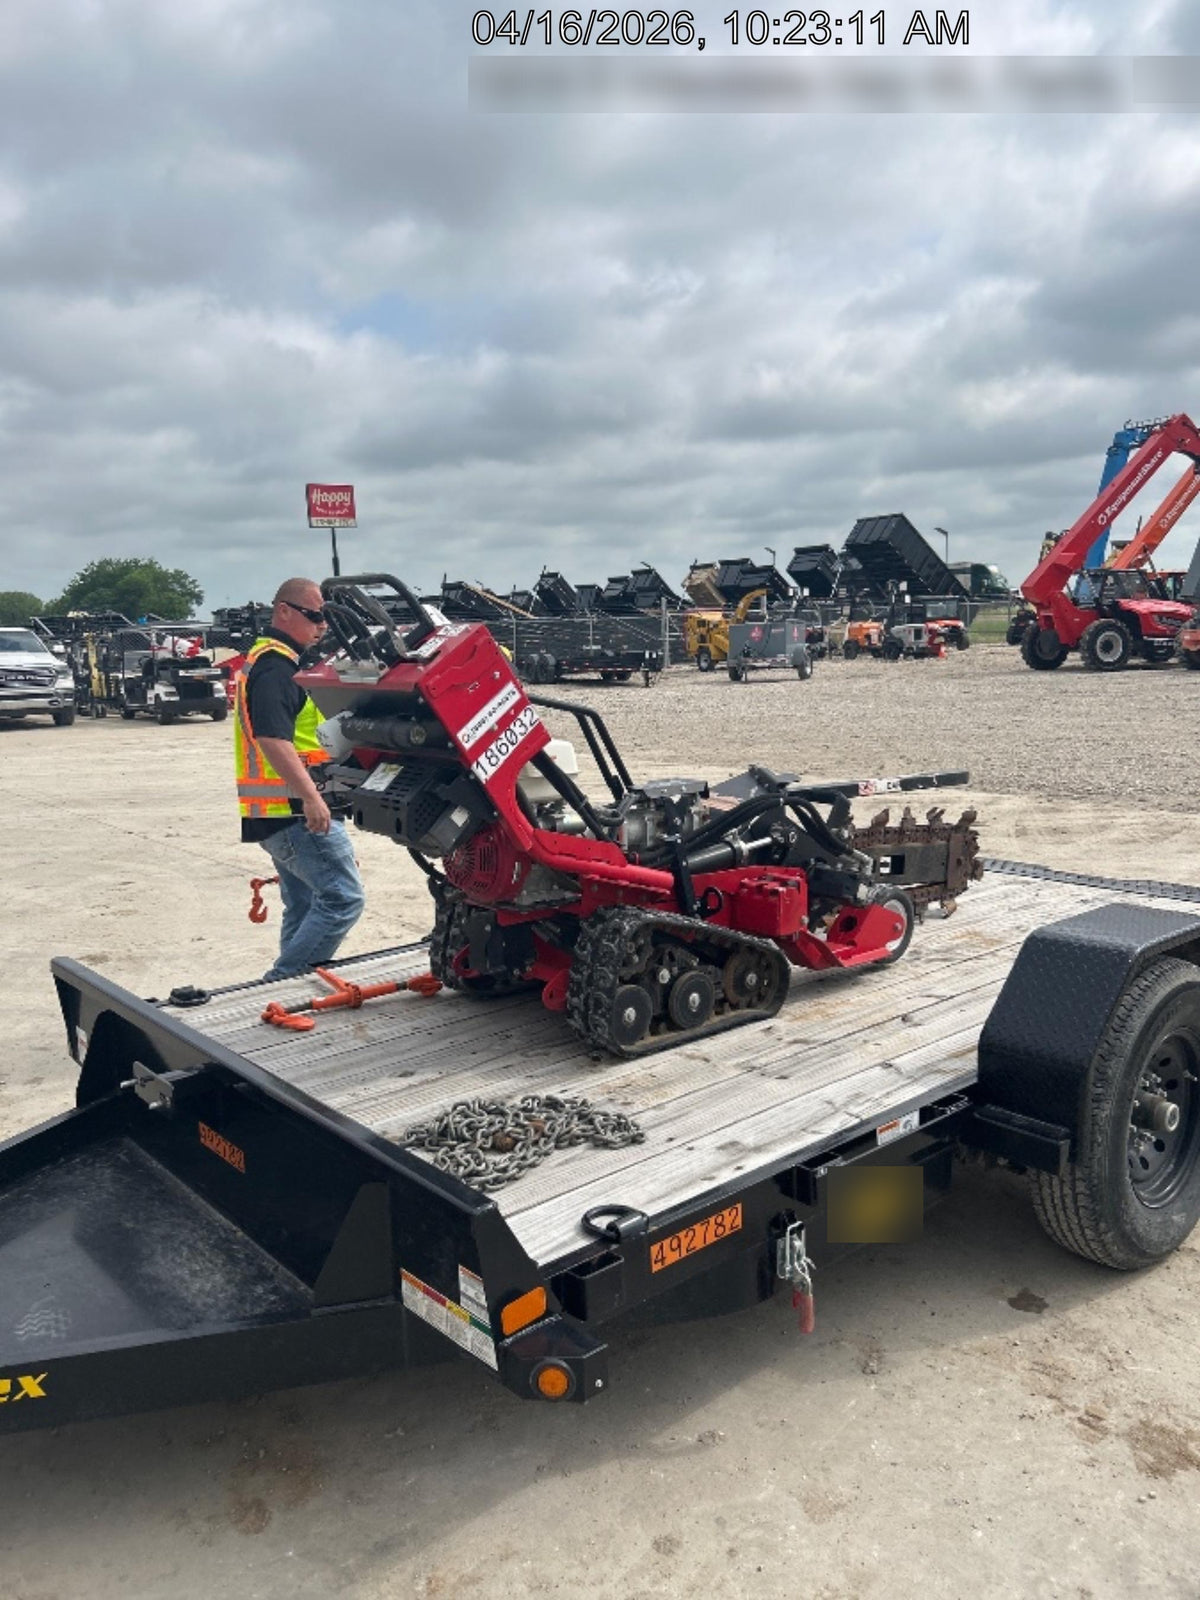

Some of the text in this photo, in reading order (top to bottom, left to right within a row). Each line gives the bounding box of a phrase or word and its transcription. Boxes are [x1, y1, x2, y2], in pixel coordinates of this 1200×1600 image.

[312, 488, 351, 507] Happy
[475, 707, 540, 776] 186032
[654, 1206, 740, 1266] 492782
